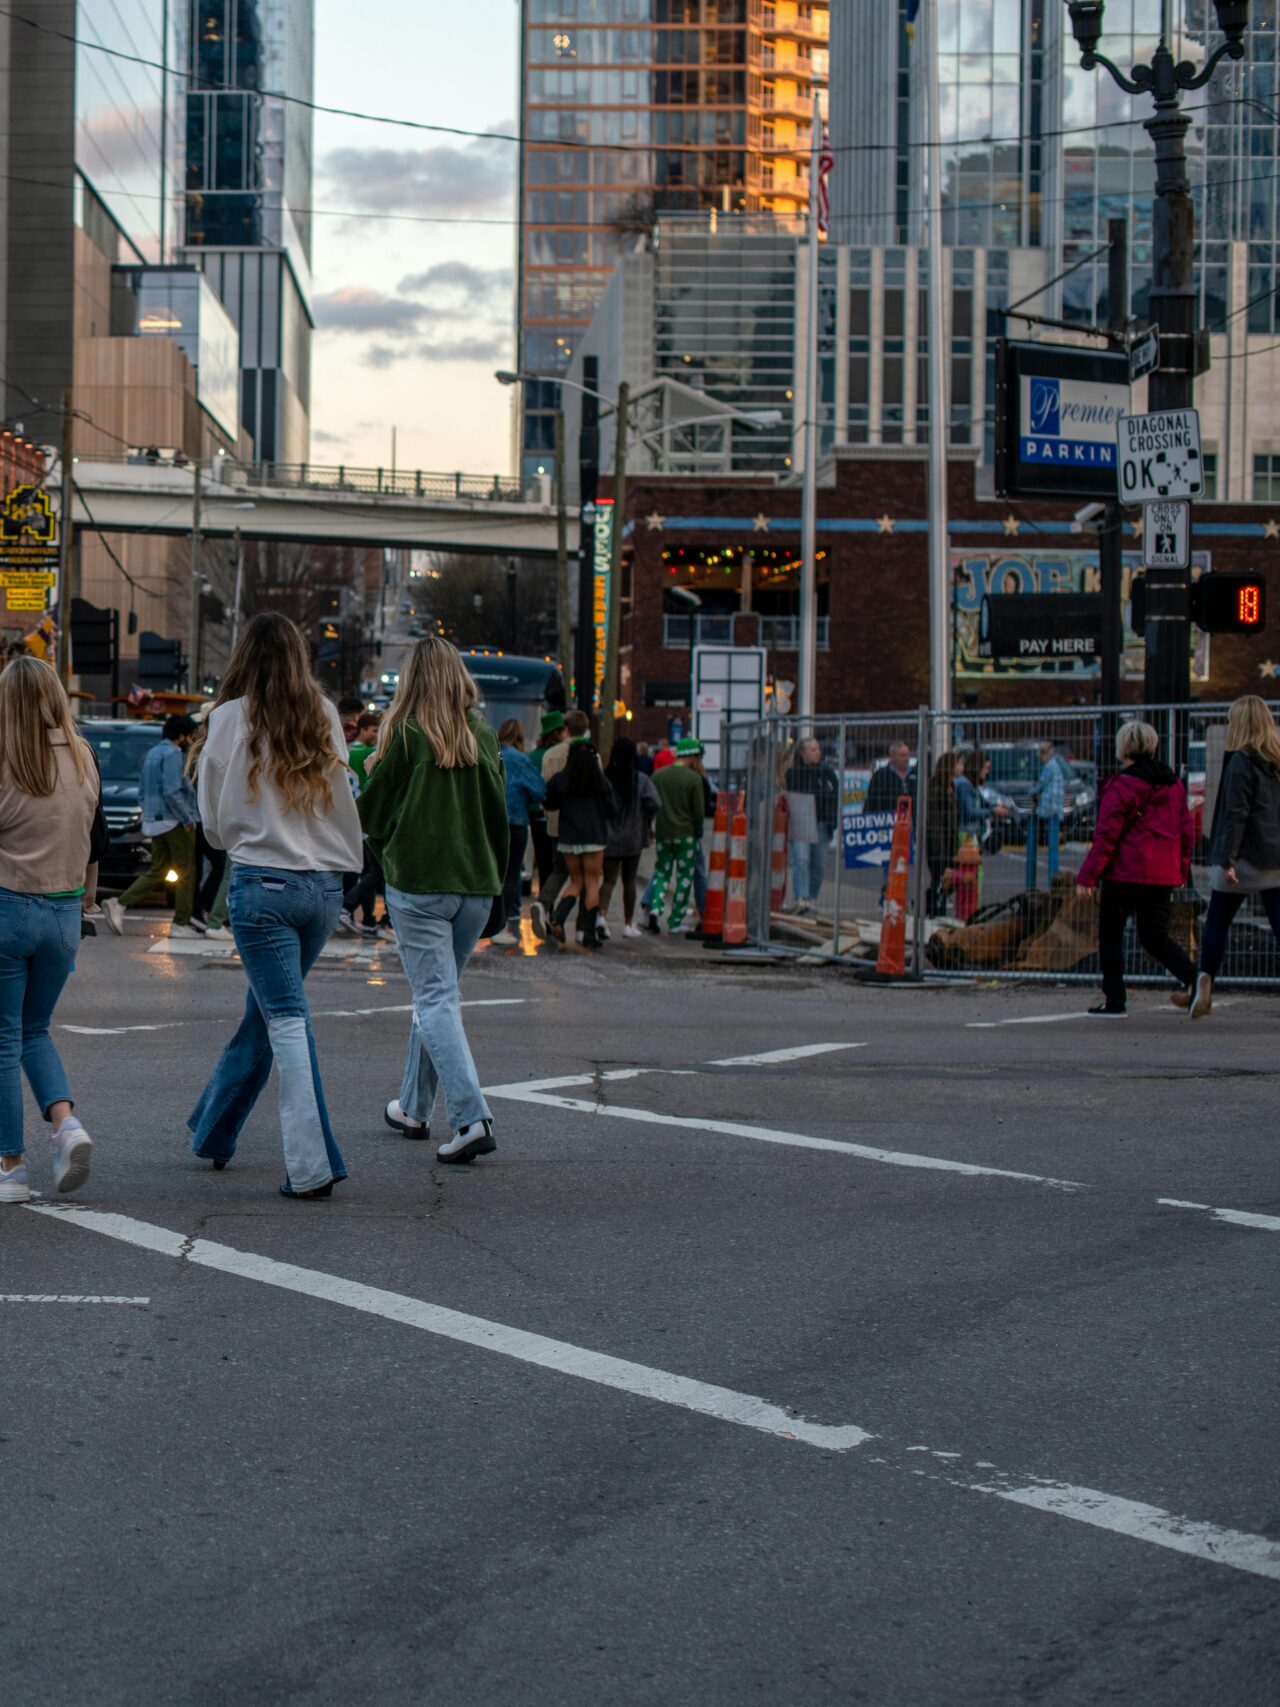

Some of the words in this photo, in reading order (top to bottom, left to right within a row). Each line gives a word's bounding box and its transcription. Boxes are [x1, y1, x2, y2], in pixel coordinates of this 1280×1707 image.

[1128, 413, 1191, 436] DIAGONAL
[1129, 431, 1192, 453] CROSSING
[1026, 440, 1112, 462] PARKIN
[1123, 457, 1156, 490] OK
[1151, 503, 1182, 513] CROSS
[1153, 513, 1178, 523] ONLY
[1159, 523, 1172, 532] ON
[1151, 556, 1179, 564] SIGNAL
[1240, 586, 1258, 623] 18
[1020, 639, 1049, 654] PAY
[1052, 638, 1095, 652] HERE
[843, 814, 897, 830] SIDEWA
[846, 829, 893, 846] CLOS
